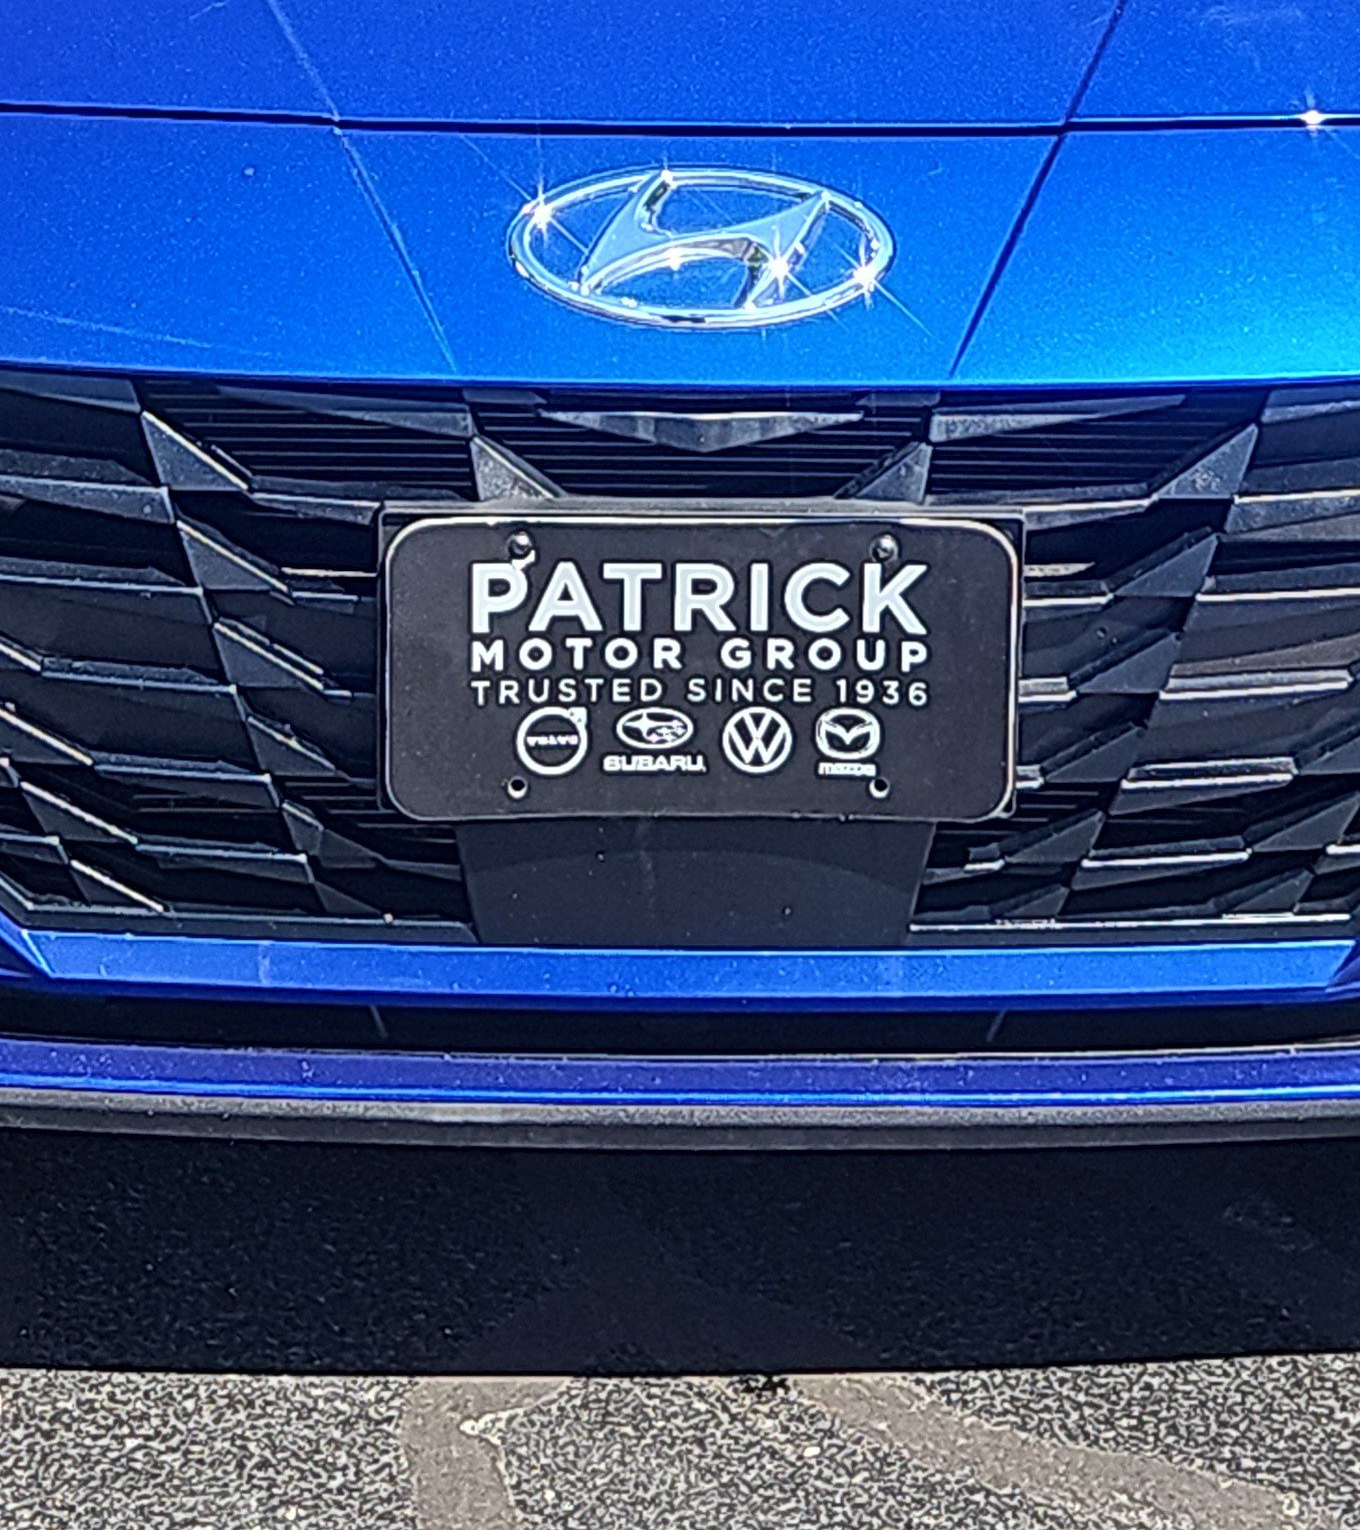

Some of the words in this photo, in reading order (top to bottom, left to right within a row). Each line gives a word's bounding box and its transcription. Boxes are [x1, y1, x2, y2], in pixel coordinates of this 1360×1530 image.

[470, 561, 928, 635] PATRICK
[471, 638, 682, 672] MOTOR
[721, 638, 928, 672] GROUP
[470, 678, 663, 706] TRUSTED
[687, 678, 813, 704] SINCE
[836, 679, 928, 707] 1936
[603, 755, 707, 773] SUBARU
